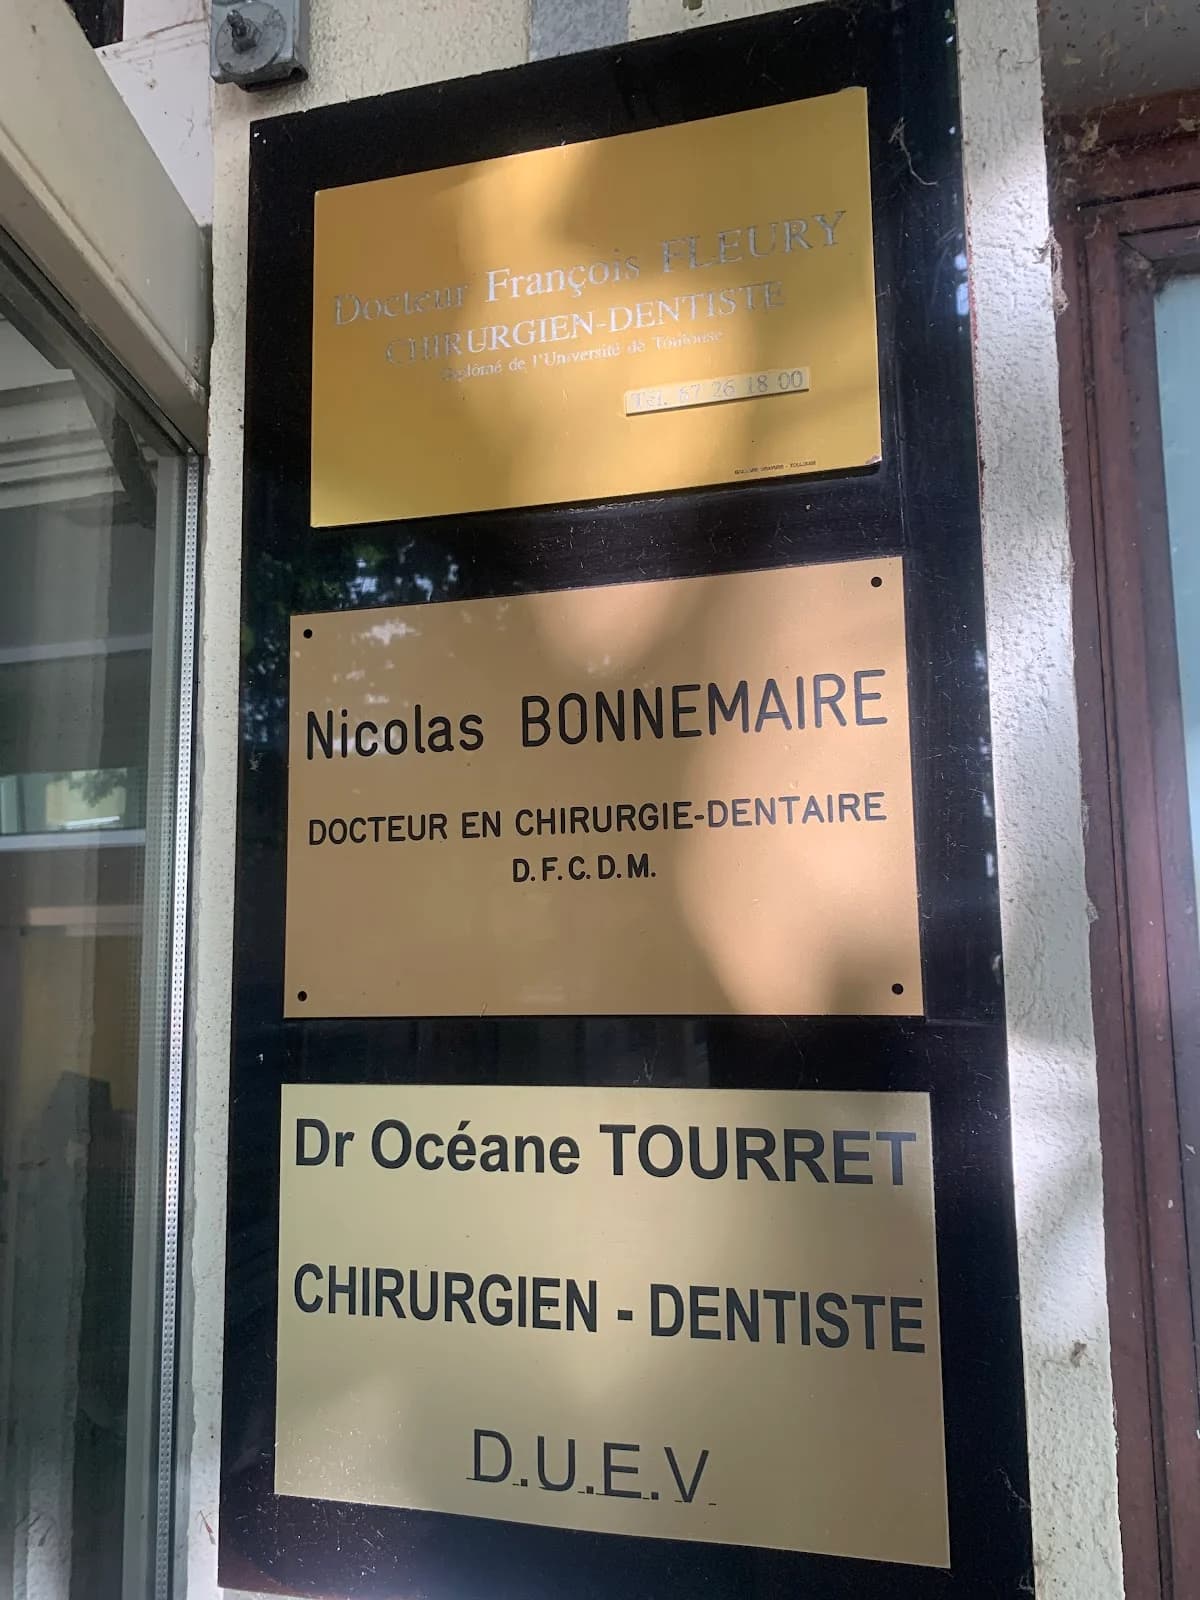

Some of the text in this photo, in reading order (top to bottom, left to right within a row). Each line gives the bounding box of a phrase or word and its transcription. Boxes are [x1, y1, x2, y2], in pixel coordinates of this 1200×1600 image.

[334, 210, 847, 326] Docteur François FLEURY
[384, 280, 785, 365] CHIRURGIEN-DENTISTE
[508, 356, 526, 372] de
[626, 341, 646, 354] de
[711, 379, 736, 398] 26
[745, 374, 769, 393] 18
[777, 370, 803, 390] 00
[305, 668, 889, 761] Nicolas BONNEMAIRE
[308, 791, 888, 846] DOCTEUR EN CHIRURGIE-DENTAIRE
[512, 852, 657, 883] D.F.C.D.M.
[295, 1117, 917, 1187] Dr Océane TOURRET
[294, 1262, 598, 1333] CHIRURGIEN
[650, 1282, 926, 1354] DENTISTE
